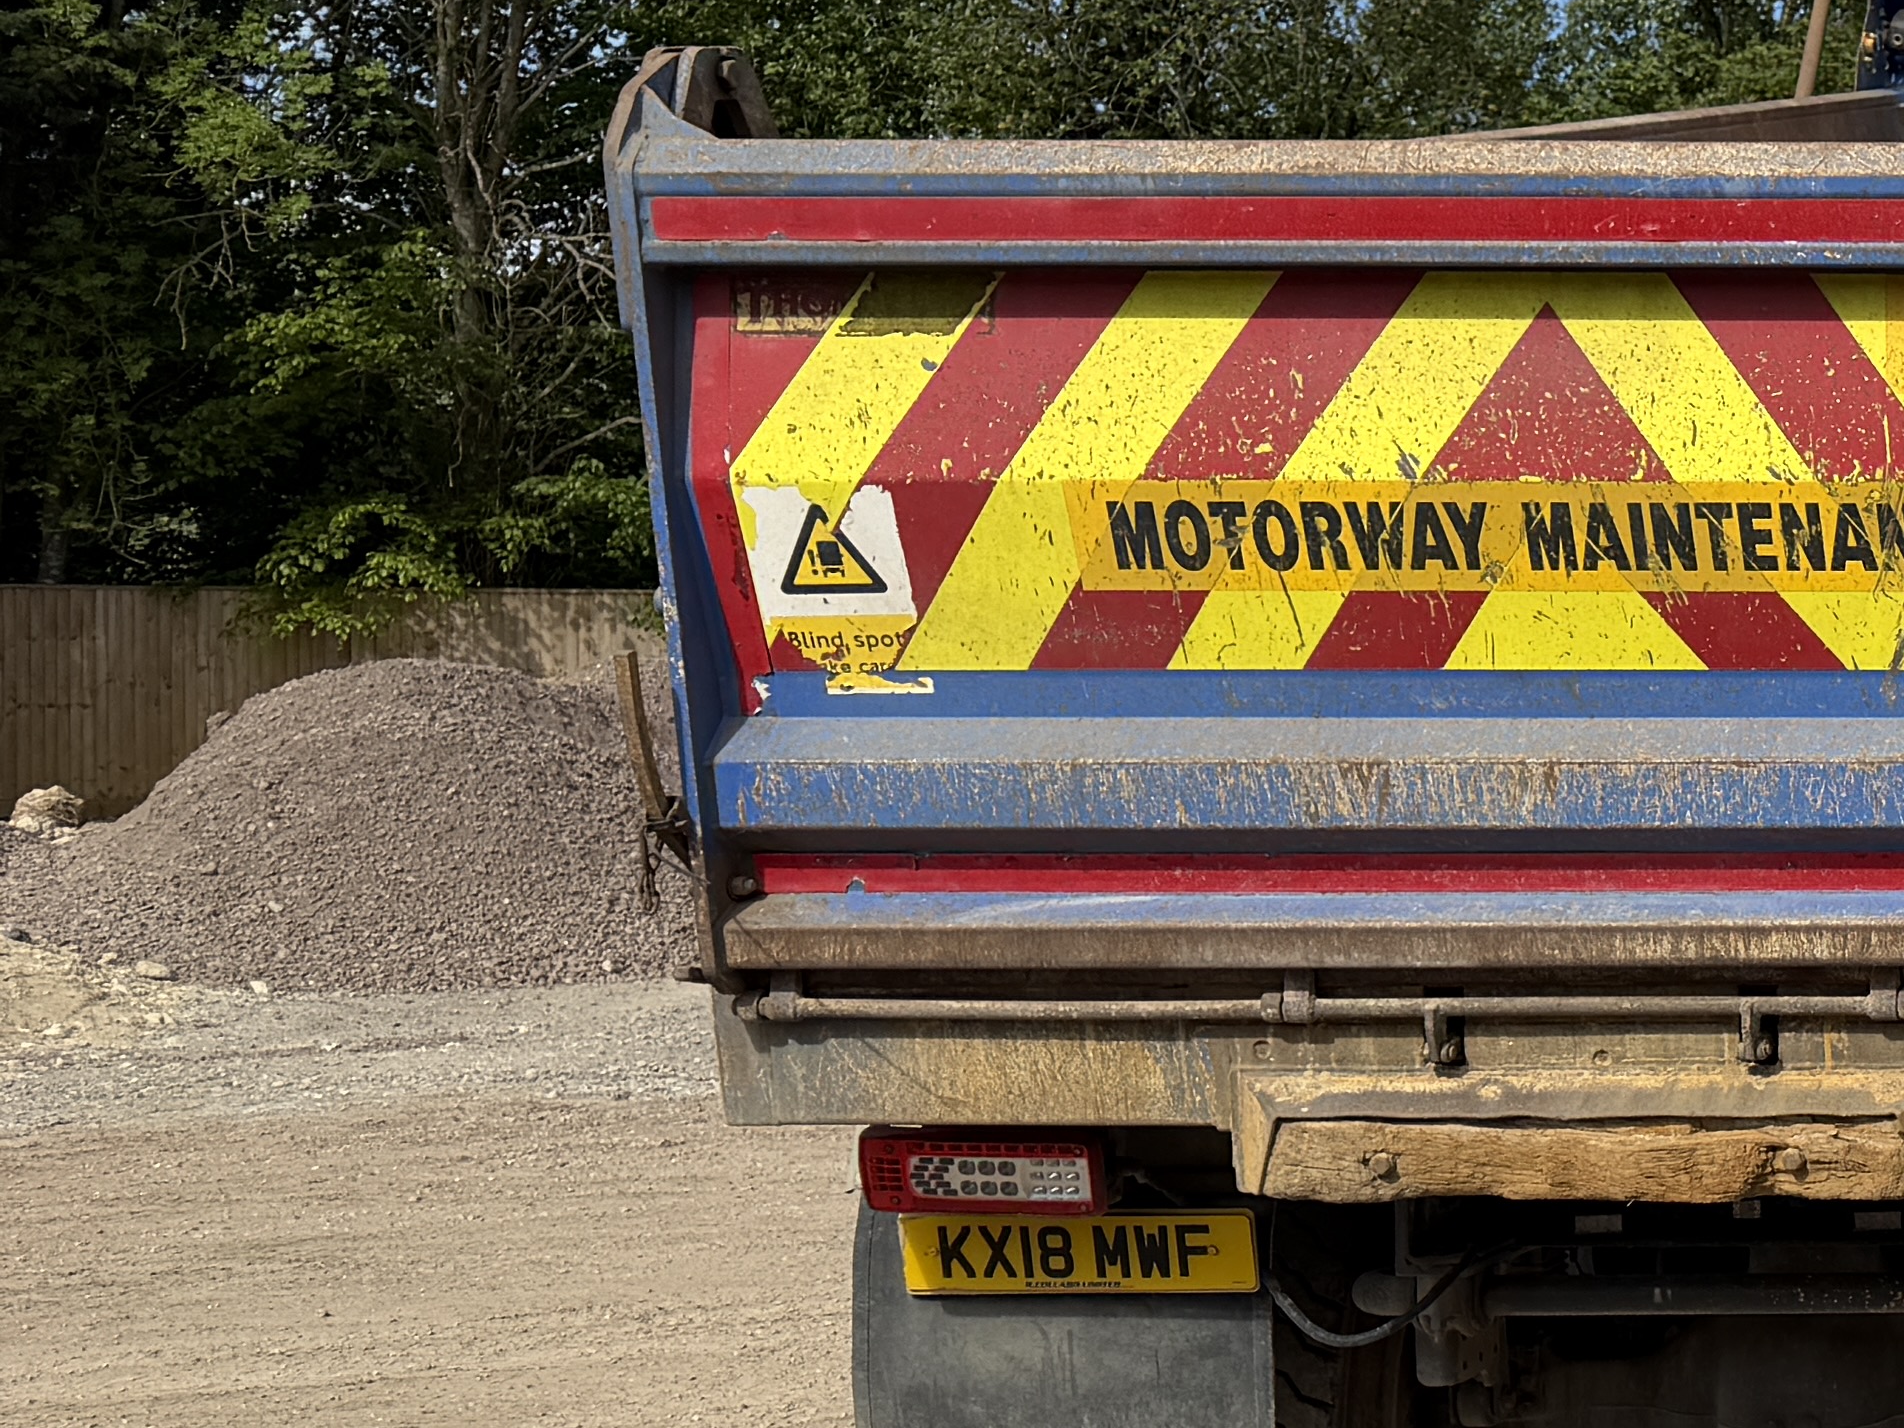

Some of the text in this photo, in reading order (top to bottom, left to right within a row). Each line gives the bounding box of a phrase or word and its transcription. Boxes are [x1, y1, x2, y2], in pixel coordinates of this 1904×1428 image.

[1106, 499, 1487, 572] MOTORWAY
[788, 631, 901, 652] Blind spot
[937, 1224, 1211, 1279] KX18 MWF
